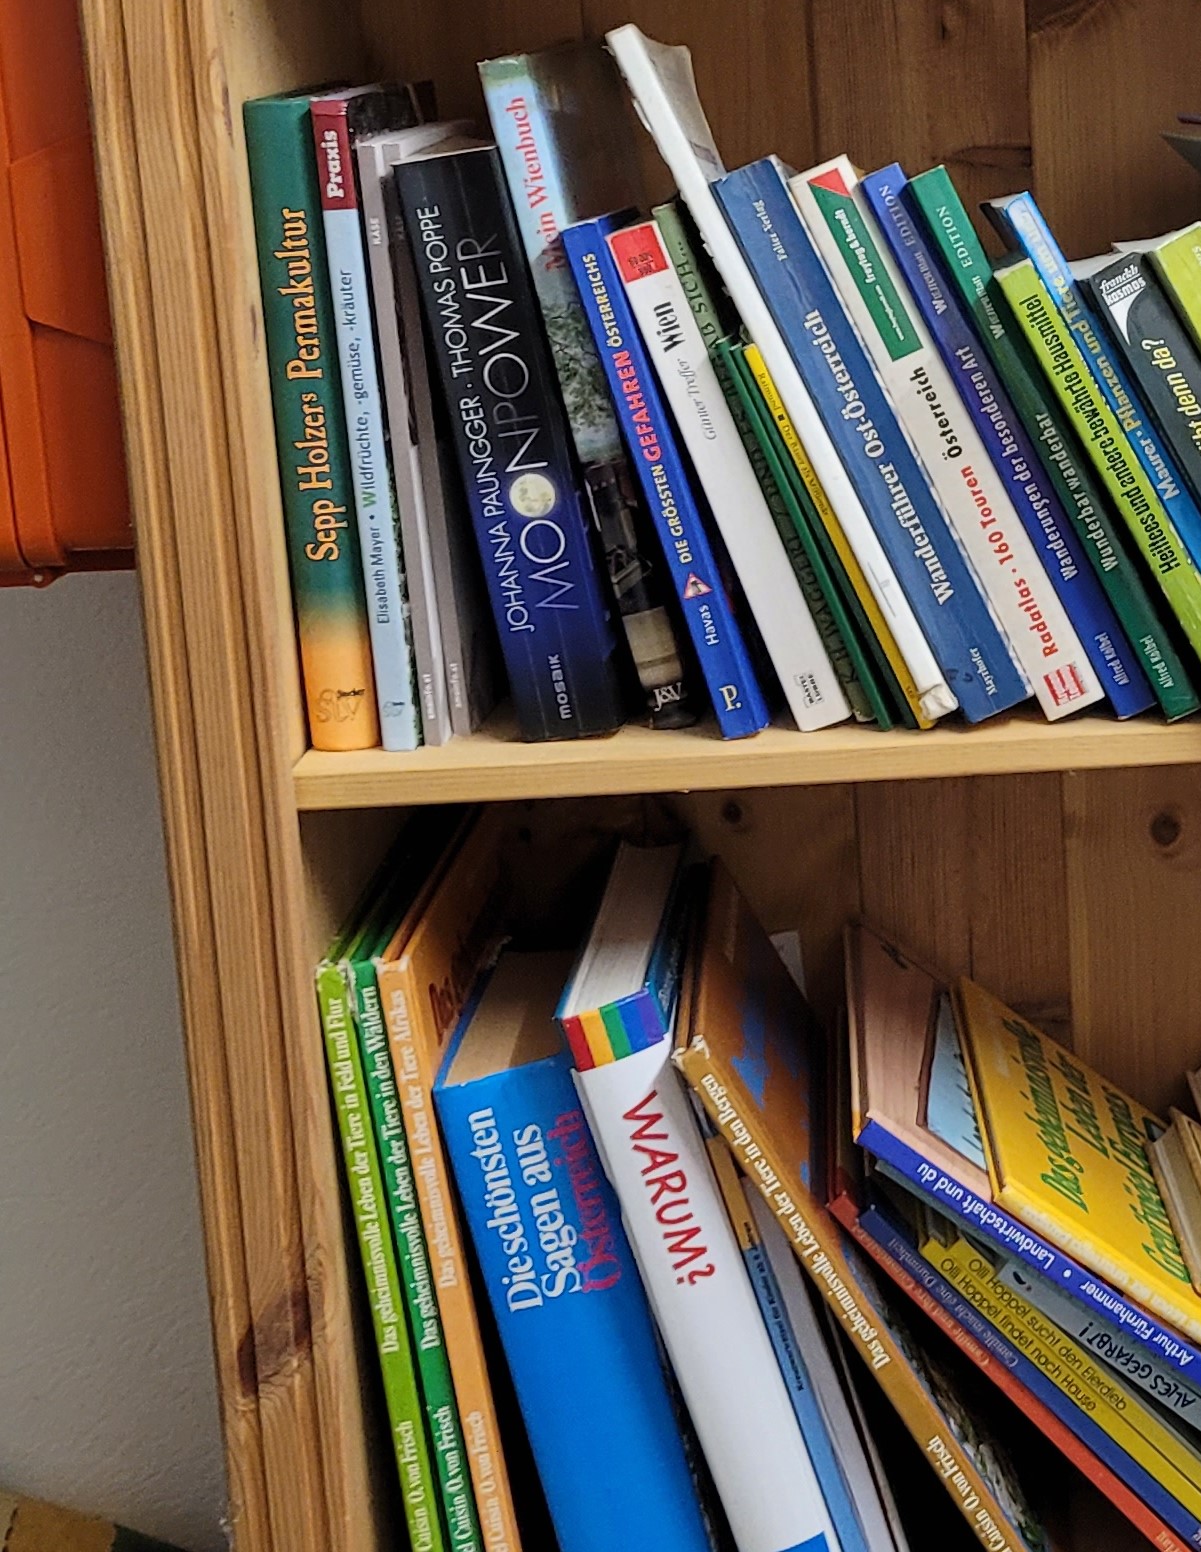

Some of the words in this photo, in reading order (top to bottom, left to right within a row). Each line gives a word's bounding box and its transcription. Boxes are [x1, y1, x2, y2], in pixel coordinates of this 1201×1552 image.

[319, 129, 344, 198] Praxis
[501, 95, 554, 210] Wienbuch
[416, 204, 451, 274] POPPE
[936, 204, 974, 268] EDITION
[269, 206, 323, 381] Permakultur
[578, 251, 624, 349] ÖSTERREICHS
[432, 277, 474, 377] THOMAS
[611, 348, 664, 463] GEFAHREN
[795, 308, 886, 462] Ost-Österreich
[903, 365, 964, 462] Österreich
[289, 391, 333, 492] Holzers
[458, 393, 506, 518] PAUNGGER
[1031, 410, 1082, 493] wanderbar
[300, 496, 351, 562] Sepp
[646, 462, 685, 538] GRÖSSTEN
[955, 464, 997, 529] Touren
[674, 538, 694, 564] DIE
[873, 459, 957, 604] Wanderführer
[985, 527, 1015, 564] 160
[1069, 489, 1120, 572] Wunderbar
[486, 519, 535, 636] JOHANNA
[695, 602, 720, 646] Havas
[1007, 576, 1059, 659] Radatlas
[323, 996, 345, 1029] Flur
[328, 1031, 350, 1061] und
[333, 1060, 355, 1091] Feld
[339, 1093, 357, 1108] in
[696, 1070, 740, 1124] Bergen
[342, 1113, 364, 1150] Tiere
[348, 1149, 368, 1175] der
[512, 1123, 552, 1185] aus
[724, 1117, 752, 1148] den
[740, 1142, 762, 1163] in
[352, 1176, 376, 1221] Leben
[462, 1106, 529, 1258] schönsten
[613, 1089, 721, 1288] WARUM?
[749, 1156, 783, 1195] Tiere
[769, 1188, 797, 1218] der
[914, 1161, 939, 1186] du
[933, 1174, 964, 1203] und
[522, 1187, 585, 1297] Sagen
[783, 1212, 821, 1257] Leben
[958, 1192, 1056, 1271] Landwirtschaft
[360, 1221, 396, 1324] geheimnisvolle
[497, 1253, 543, 1313] Die
[806, 1248, 877, 1345] geheimnisvolle
[377, 1325, 398, 1354] Das
[937, 1256, 962, 1281] Olli
[955, 1272, 1003, 1320] Hoppel
[996, 1314, 1034, 1353] findet
[1028, 1345, 1063, 1380] nach
[1058, 1373, 1097, 1413] Hause
[967, 1256, 990, 1279] Olli
[984, 1272, 1033, 1320] Hoppel
[1025, 1312, 1062, 1349] sucht
[1056, 1342, 1085, 1371] den
[1080, 1365, 1128, 1413] Eierdieb
[1077, 1277, 1155, 1341] Fürnhammer
[861, 1338, 891, 1370] Das
[1148, 1330, 1193, 1369] Arthur
